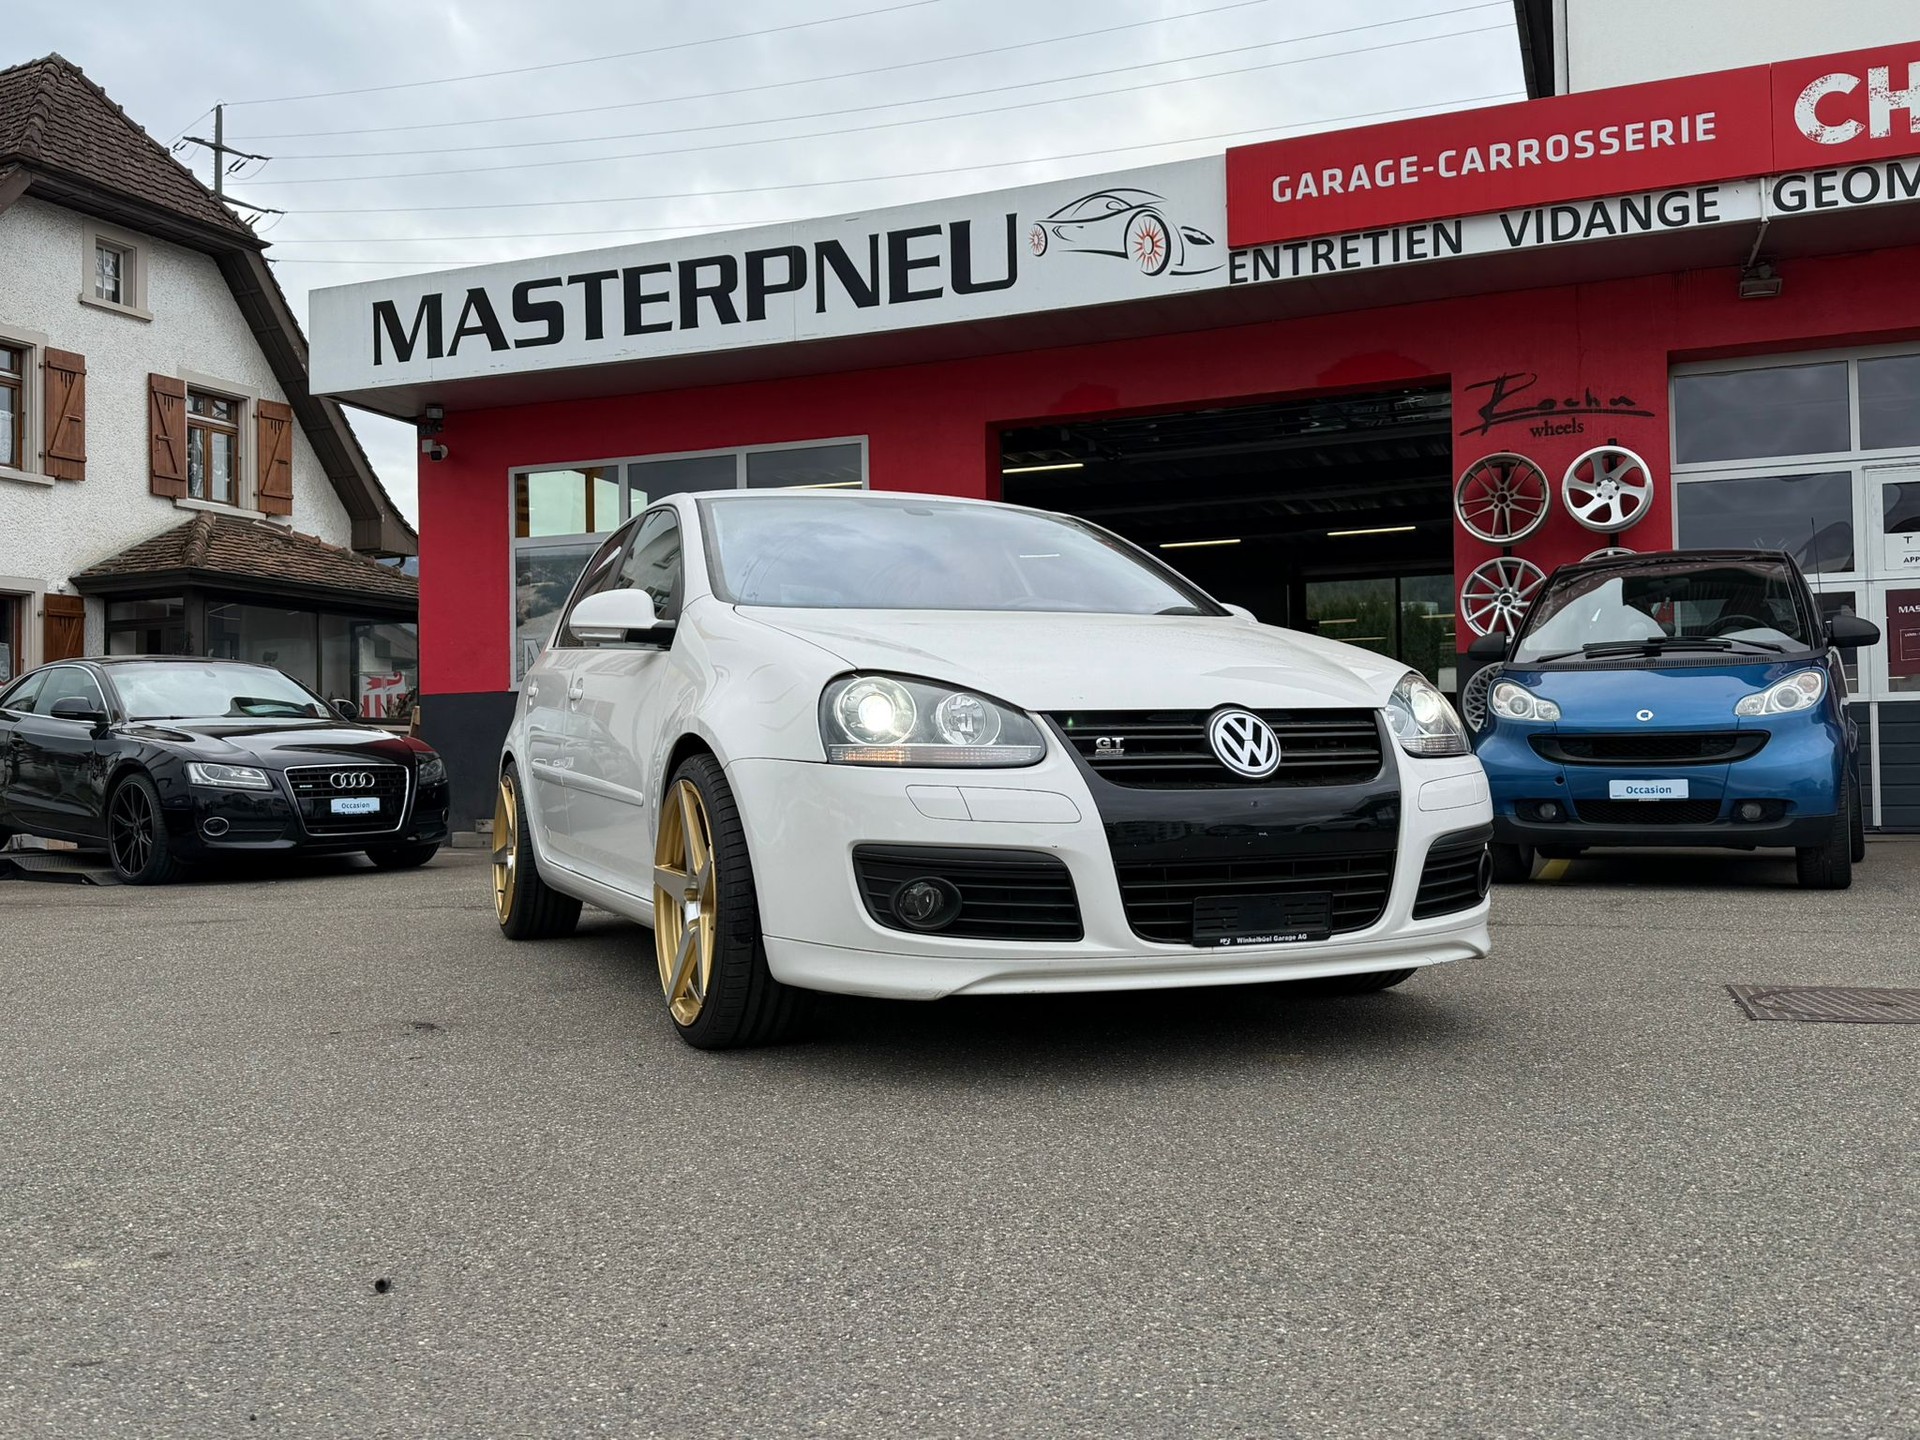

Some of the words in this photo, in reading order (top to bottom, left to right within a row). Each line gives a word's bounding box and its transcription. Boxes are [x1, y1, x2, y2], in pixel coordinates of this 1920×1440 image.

[1793, 62, 1920, 147] CH
[1271, 112, 1717, 203] GARAGE-CARROSSERIE
[1228, 219, 1462, 285] ENTRETIEN
[1500, 186, 1720, 247] VIDANGE
[372, 212, 1018, 367] MASTERPNEU
[1529, 417, 1585, 438] wheels
[1095, 737, 1125, 748] GT
[1625, 785, 1672, 794] Occasion
[1273, 934, 1297, 943] Garage
[1297, 933, 1308, 941] AG
